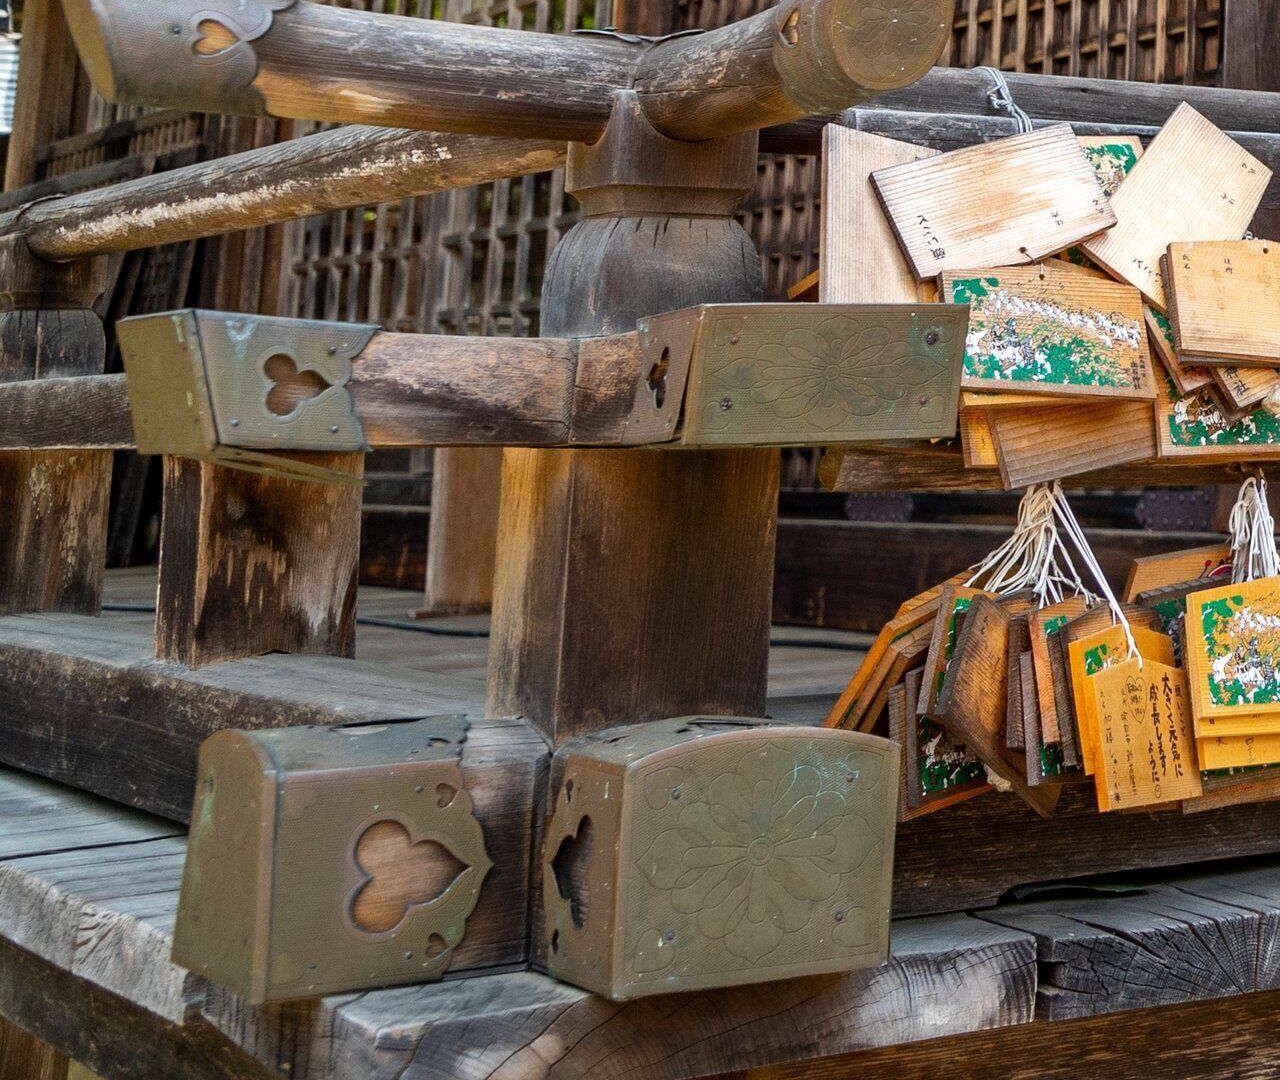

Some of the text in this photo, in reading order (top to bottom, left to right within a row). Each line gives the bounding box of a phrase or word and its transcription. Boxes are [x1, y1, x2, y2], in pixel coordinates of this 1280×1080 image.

[1161, 672, 1184, 779] 大きく元気に
[1174, 683, 1187, 738] 願いごと
